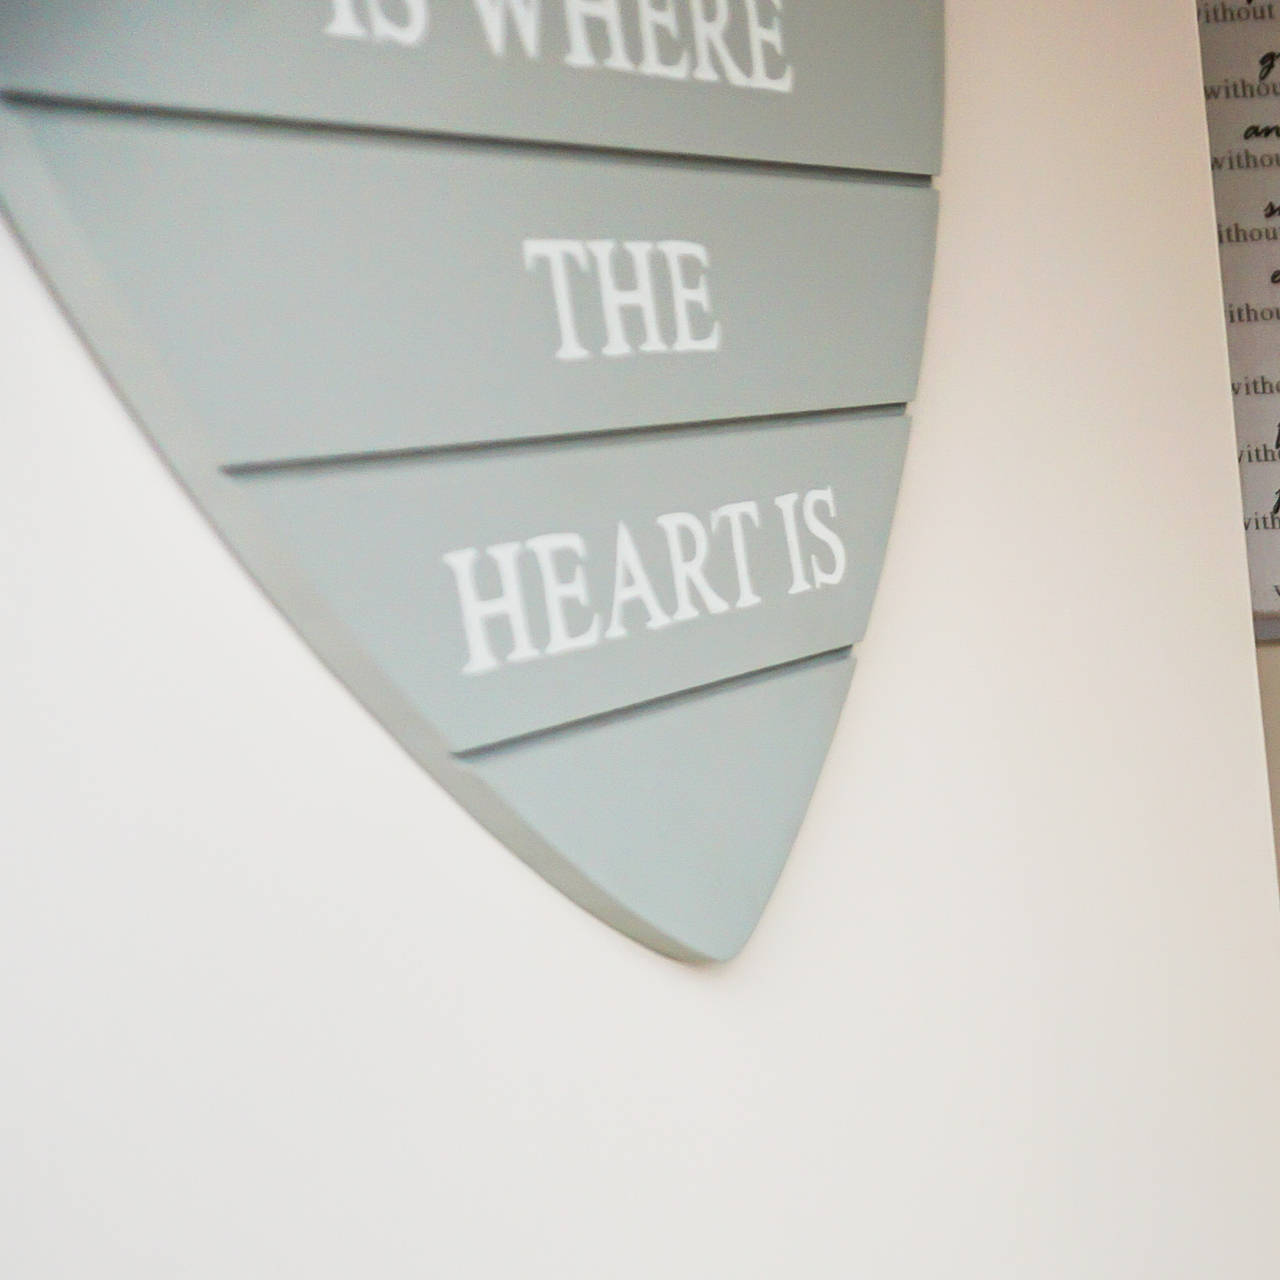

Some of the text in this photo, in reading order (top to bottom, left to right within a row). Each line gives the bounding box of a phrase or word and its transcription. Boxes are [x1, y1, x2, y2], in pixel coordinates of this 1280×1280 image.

[1198, 2, 1275, 24] ithout
[523, 239, 720, 362] THE
[443, 484, 848, 675] HEART IS
